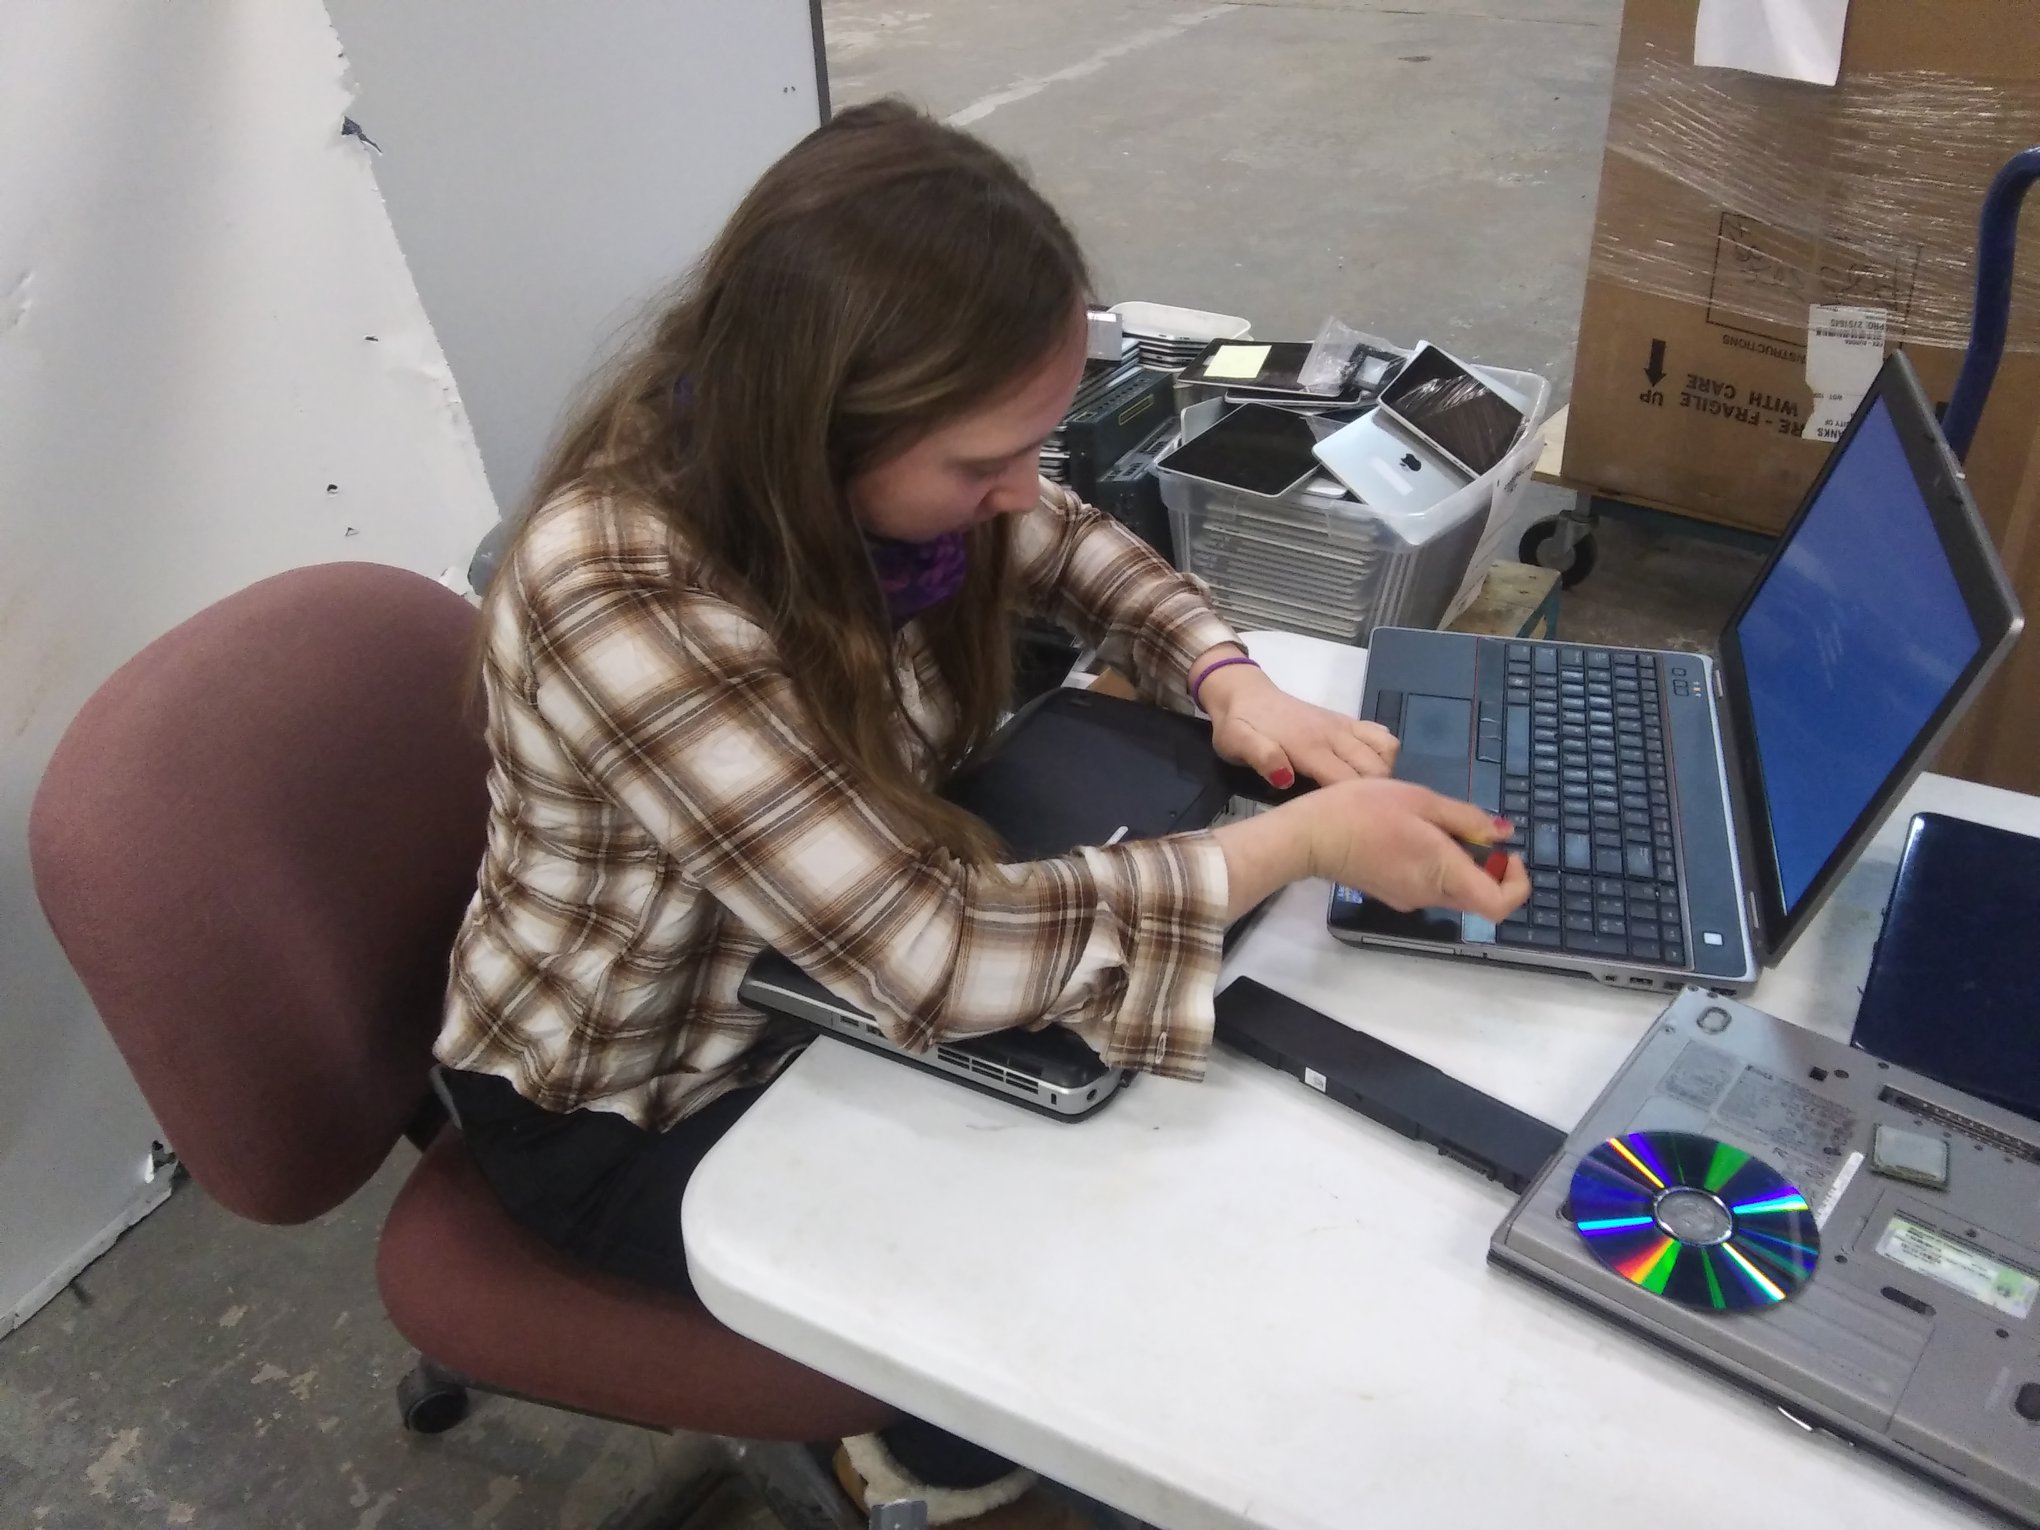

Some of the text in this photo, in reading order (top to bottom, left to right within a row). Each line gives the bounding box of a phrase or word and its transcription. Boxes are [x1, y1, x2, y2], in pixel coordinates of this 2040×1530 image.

[1640, 388, 1664, 406] UP
[1680, 391, 1760, 427] FRAGILE
[1687, 373, 1799, 418] WITH CARE
